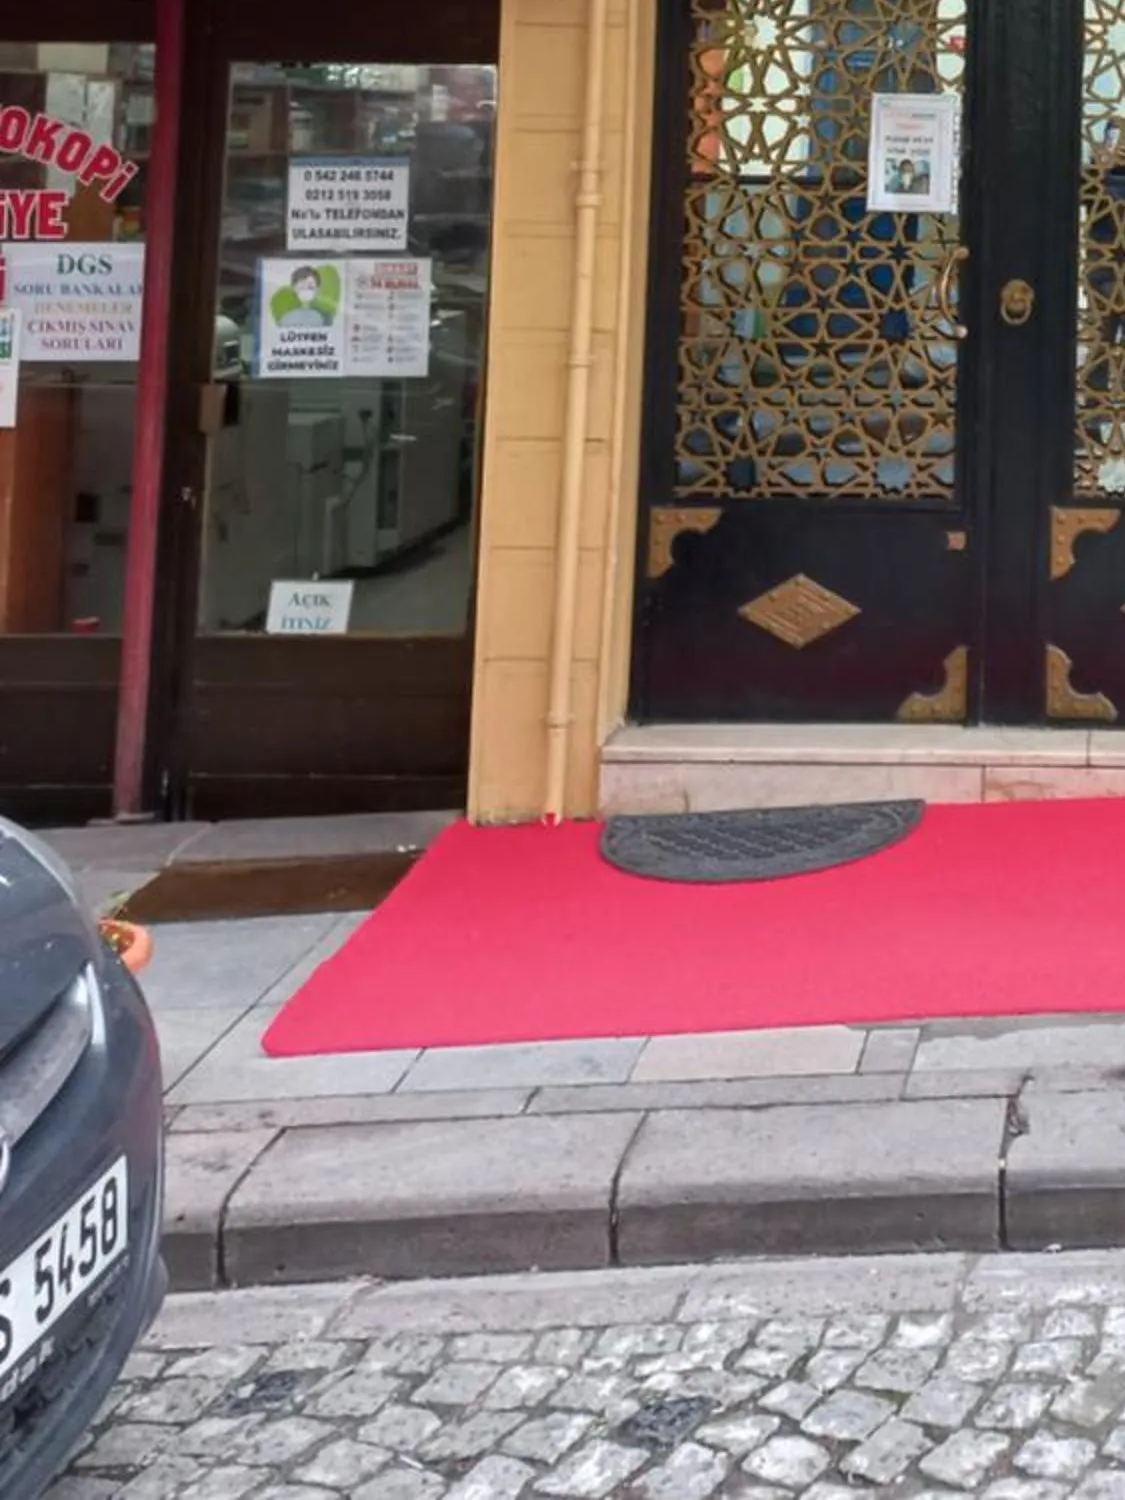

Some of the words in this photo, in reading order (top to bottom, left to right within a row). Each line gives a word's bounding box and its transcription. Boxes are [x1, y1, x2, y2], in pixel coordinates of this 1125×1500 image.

[57, 253, 113, 275] DGS
[14, 284, 54, 296] SORU
[34, 1176, 118, 1325] 5458
